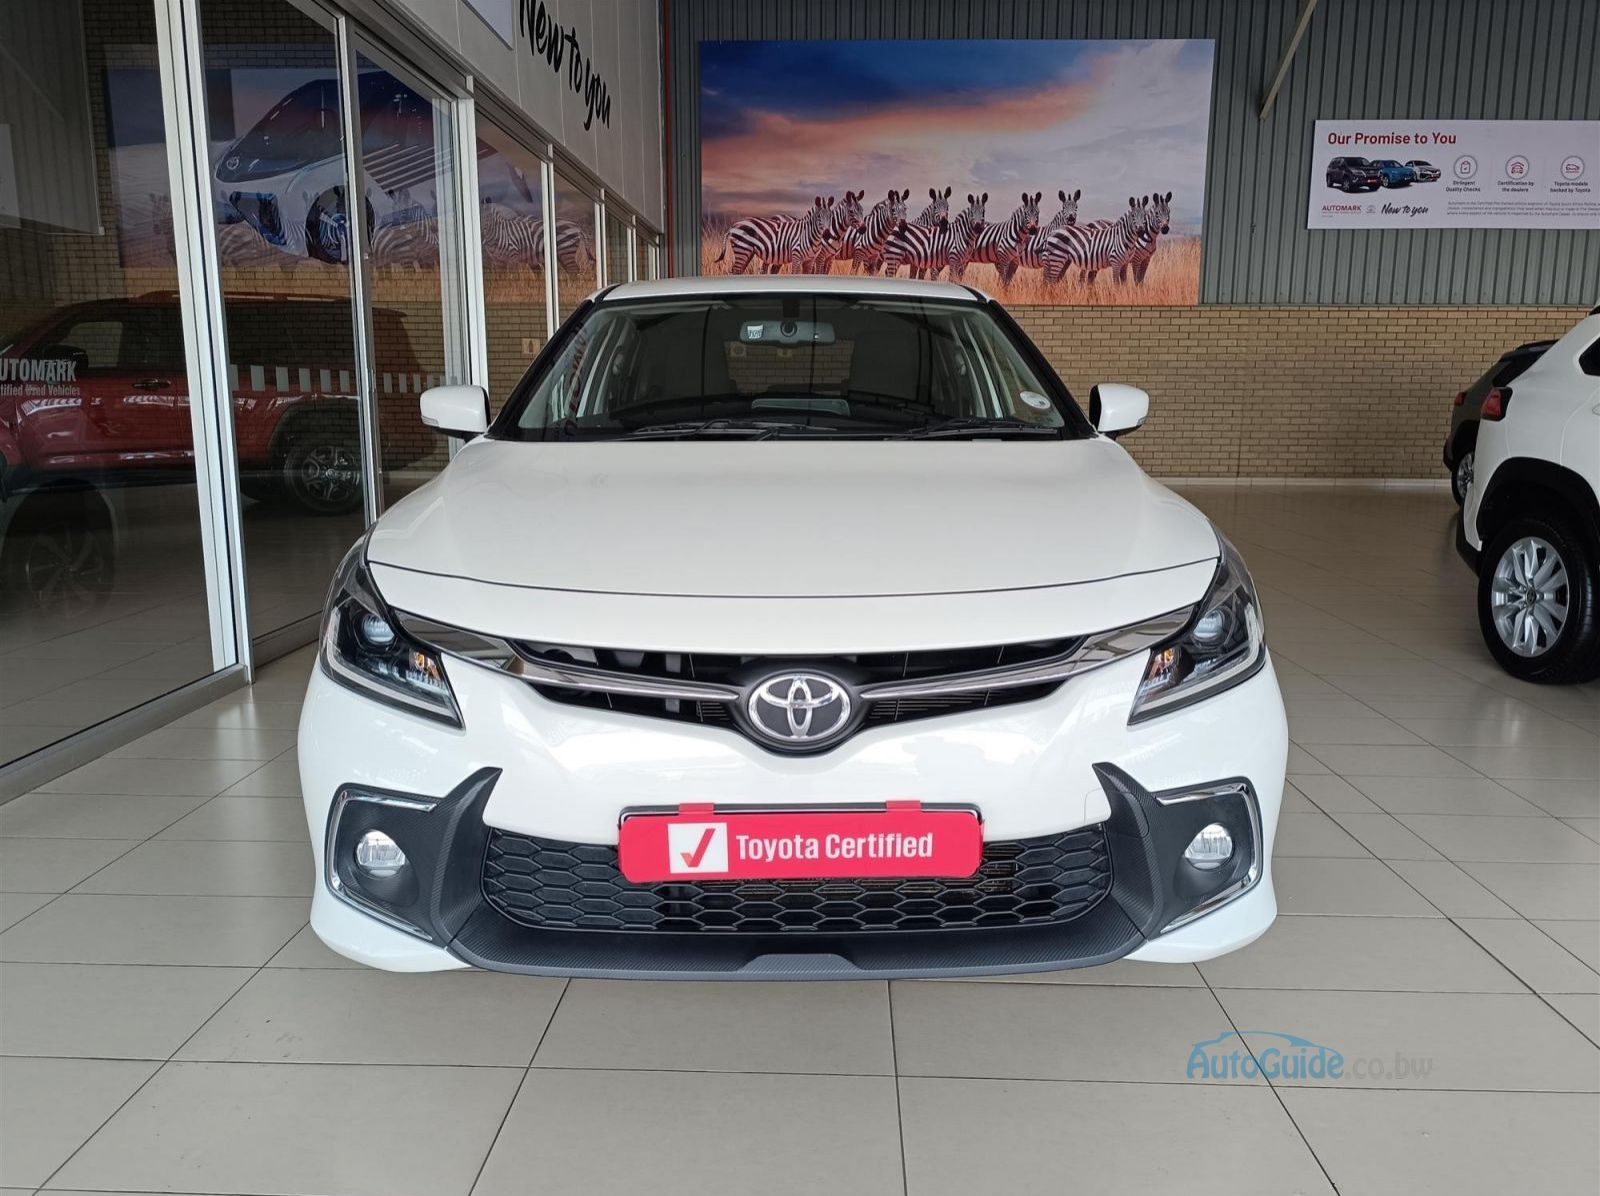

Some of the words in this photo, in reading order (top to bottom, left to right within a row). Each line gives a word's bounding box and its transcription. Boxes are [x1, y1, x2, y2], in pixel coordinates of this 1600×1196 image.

[519, 0, 565, 73] New
[564, 26, 583, 94] to
[583, 57, 611, 132] you
[1328, 133, 1351, 145] Our
[1354, 132, 1410, 145] Promise
[1414, 133, 1428, 145] to
[1432, 132, 1457, 145] You
[1321, 204, 1362, 212] AUTOMARK
[1381, 202, 1401, 215] New
[1402, 204, 1410, 214] to
[1410, 205, 1429, 218] you
[0, 358, 77, 382] UTOMARK
[47, 384, 81, 396] Vehicles
[736, 834, 820, 863] Toyota
[825, 833, 934, 860] Certified
